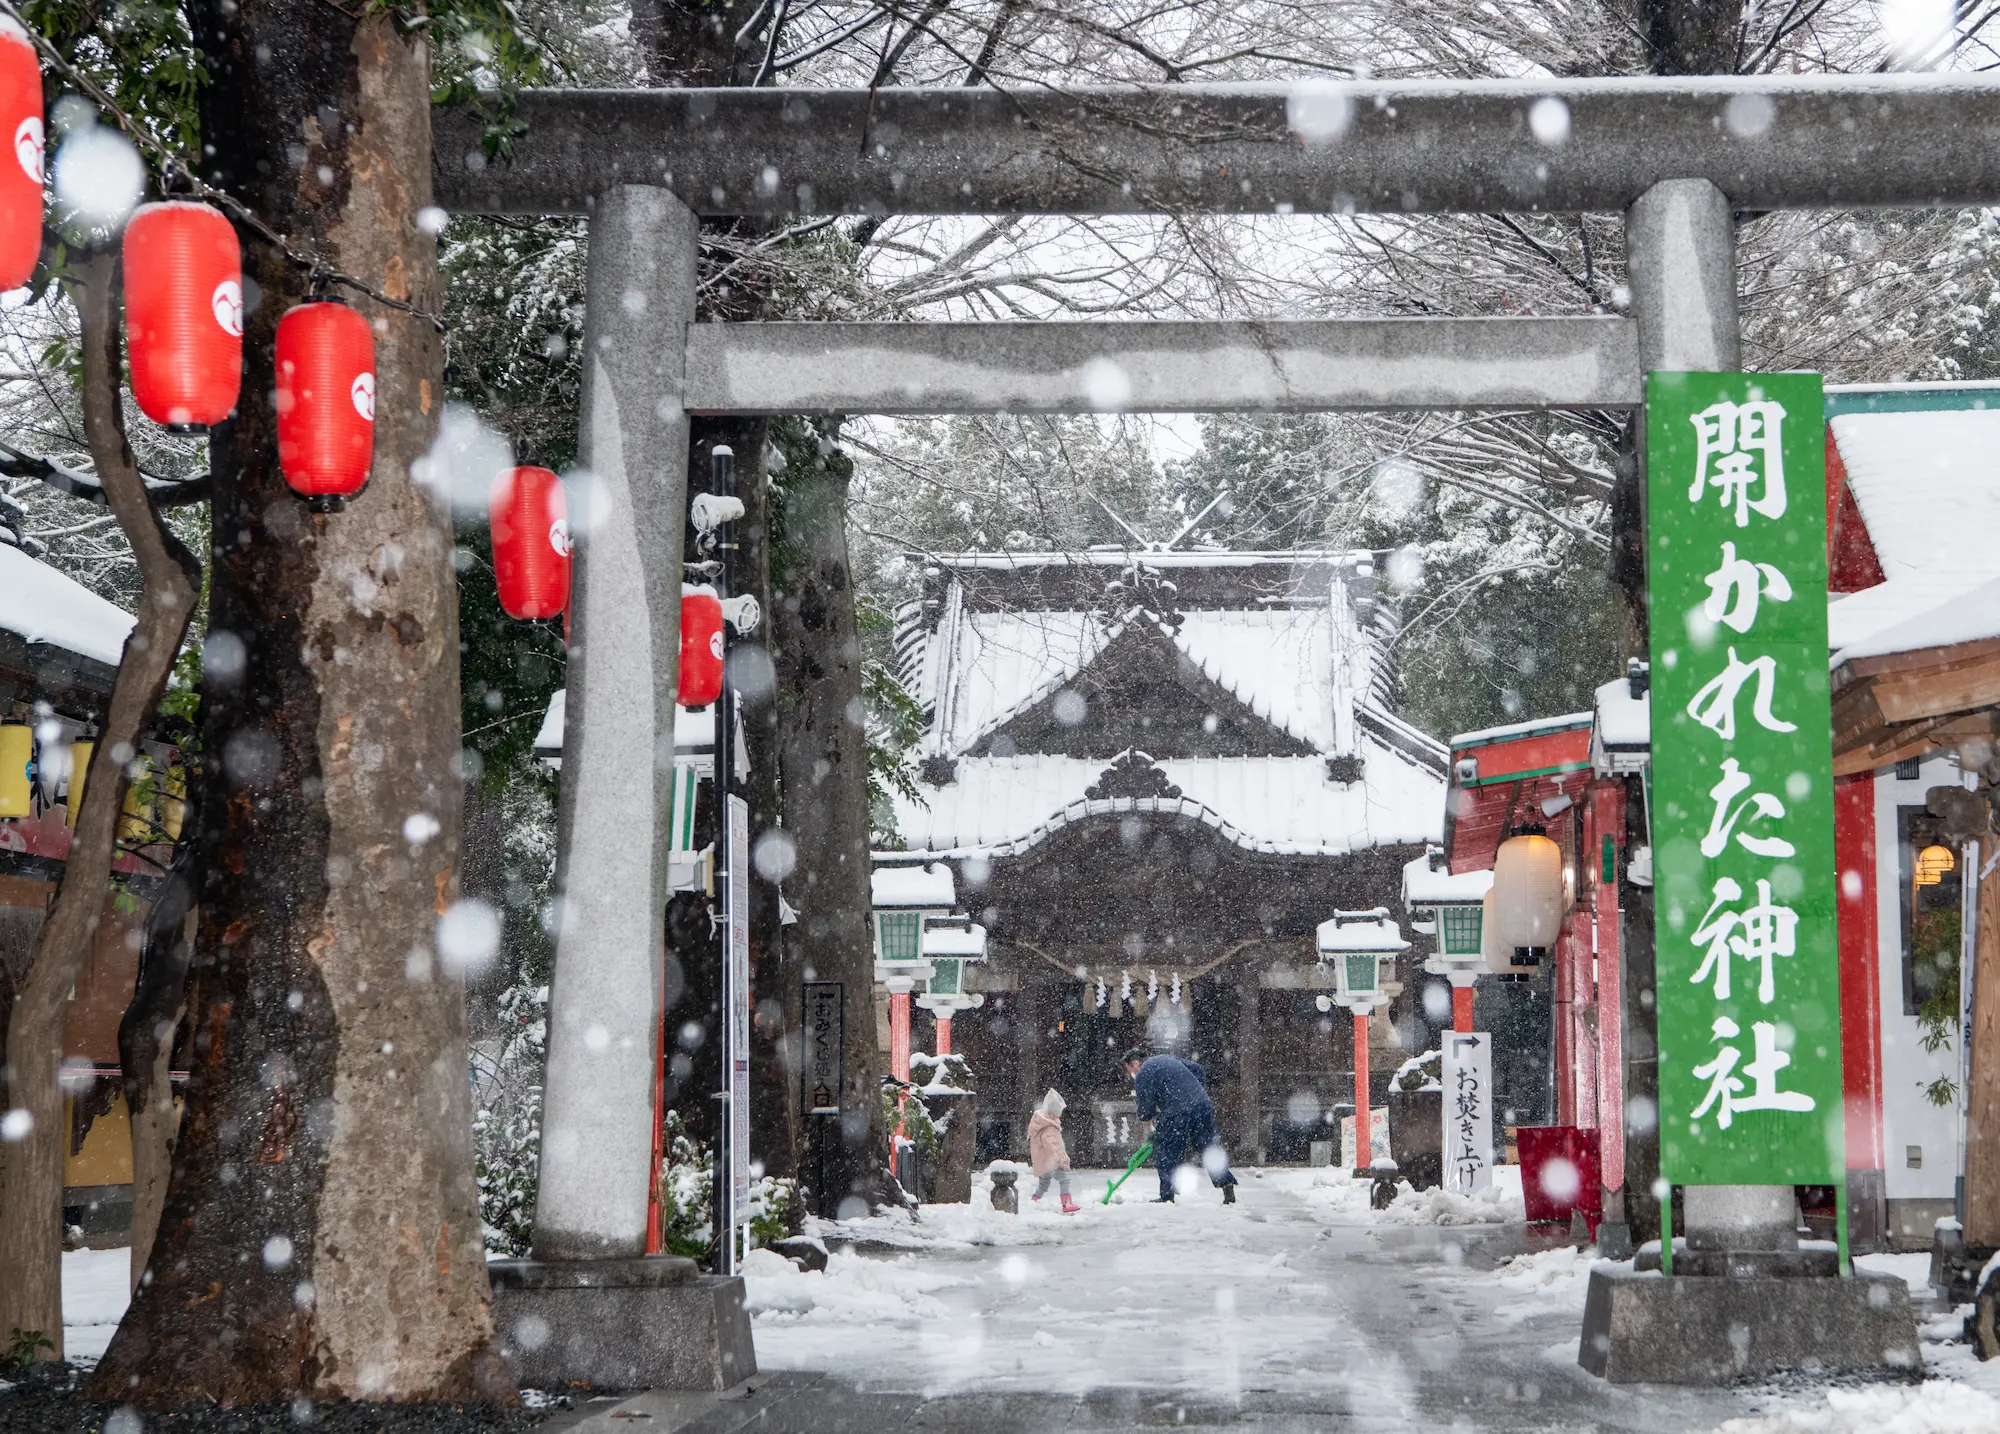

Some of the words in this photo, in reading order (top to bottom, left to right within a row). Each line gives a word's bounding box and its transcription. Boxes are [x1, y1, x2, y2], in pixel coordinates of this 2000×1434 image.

[1687, 400, 1815, 1130] 開かれた神社
[813, 1003, 832, 1108] おみくじ処入口
[1455, 1067, 1483, 1198] お焚き上げ
